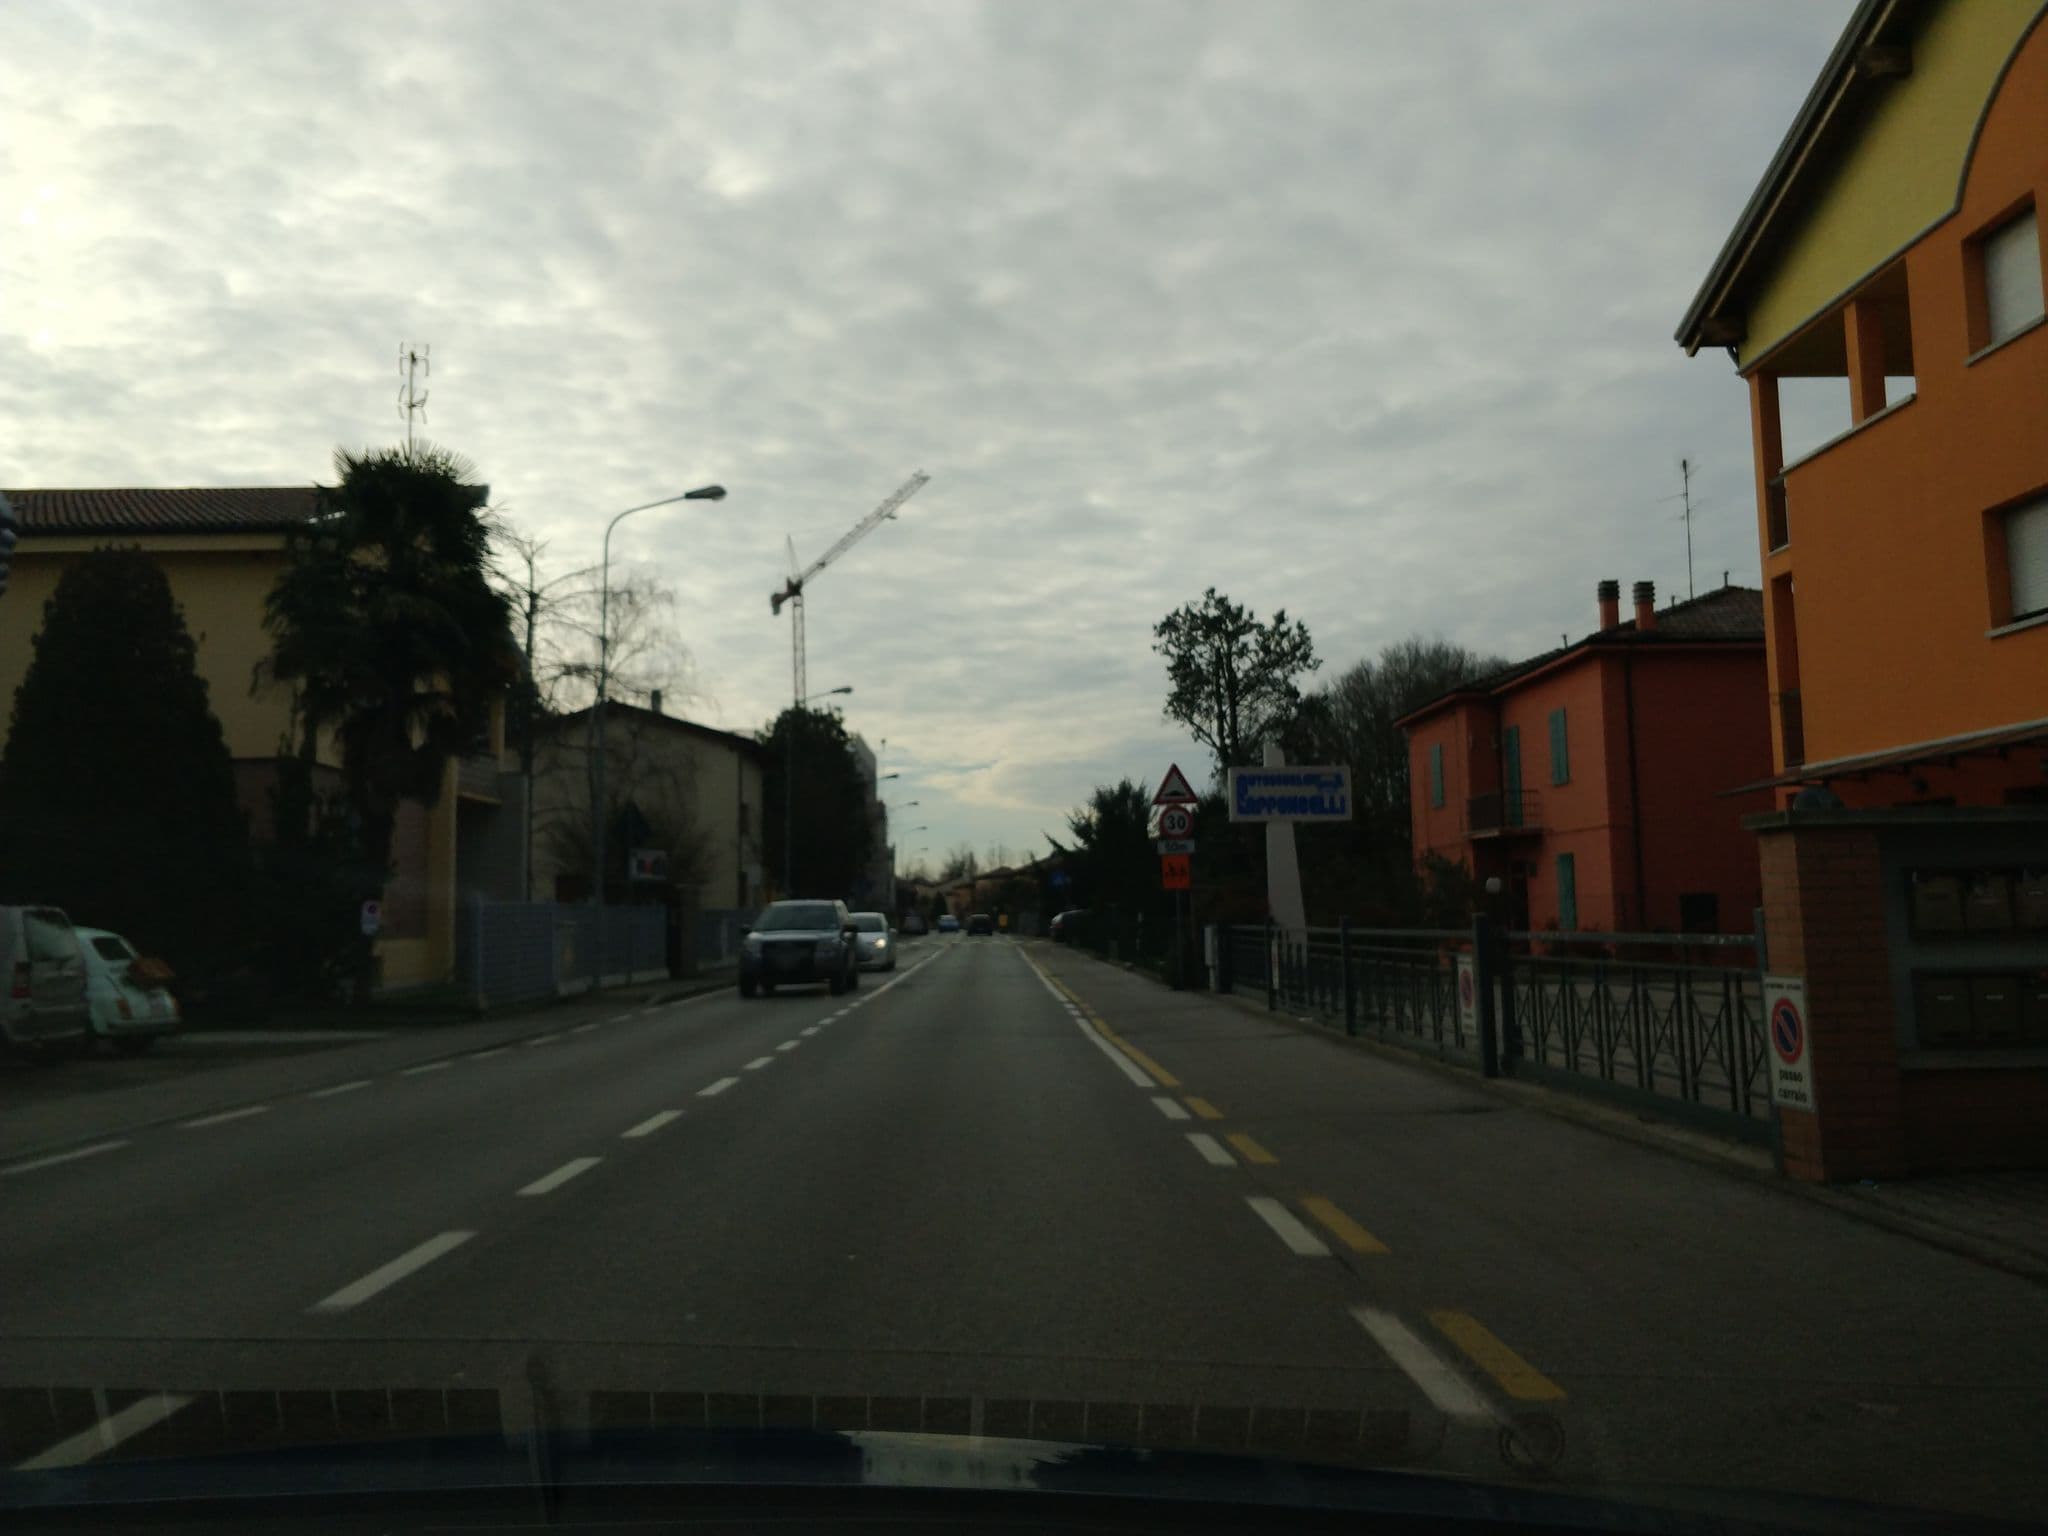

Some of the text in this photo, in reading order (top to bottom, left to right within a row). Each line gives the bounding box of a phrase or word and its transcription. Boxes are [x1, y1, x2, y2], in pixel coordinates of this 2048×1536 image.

[1167, 815, 1186, 830] 30
[1779, 1069, 1803, 1083] passo
[1777, 1087, 1807, 1104] carraio
